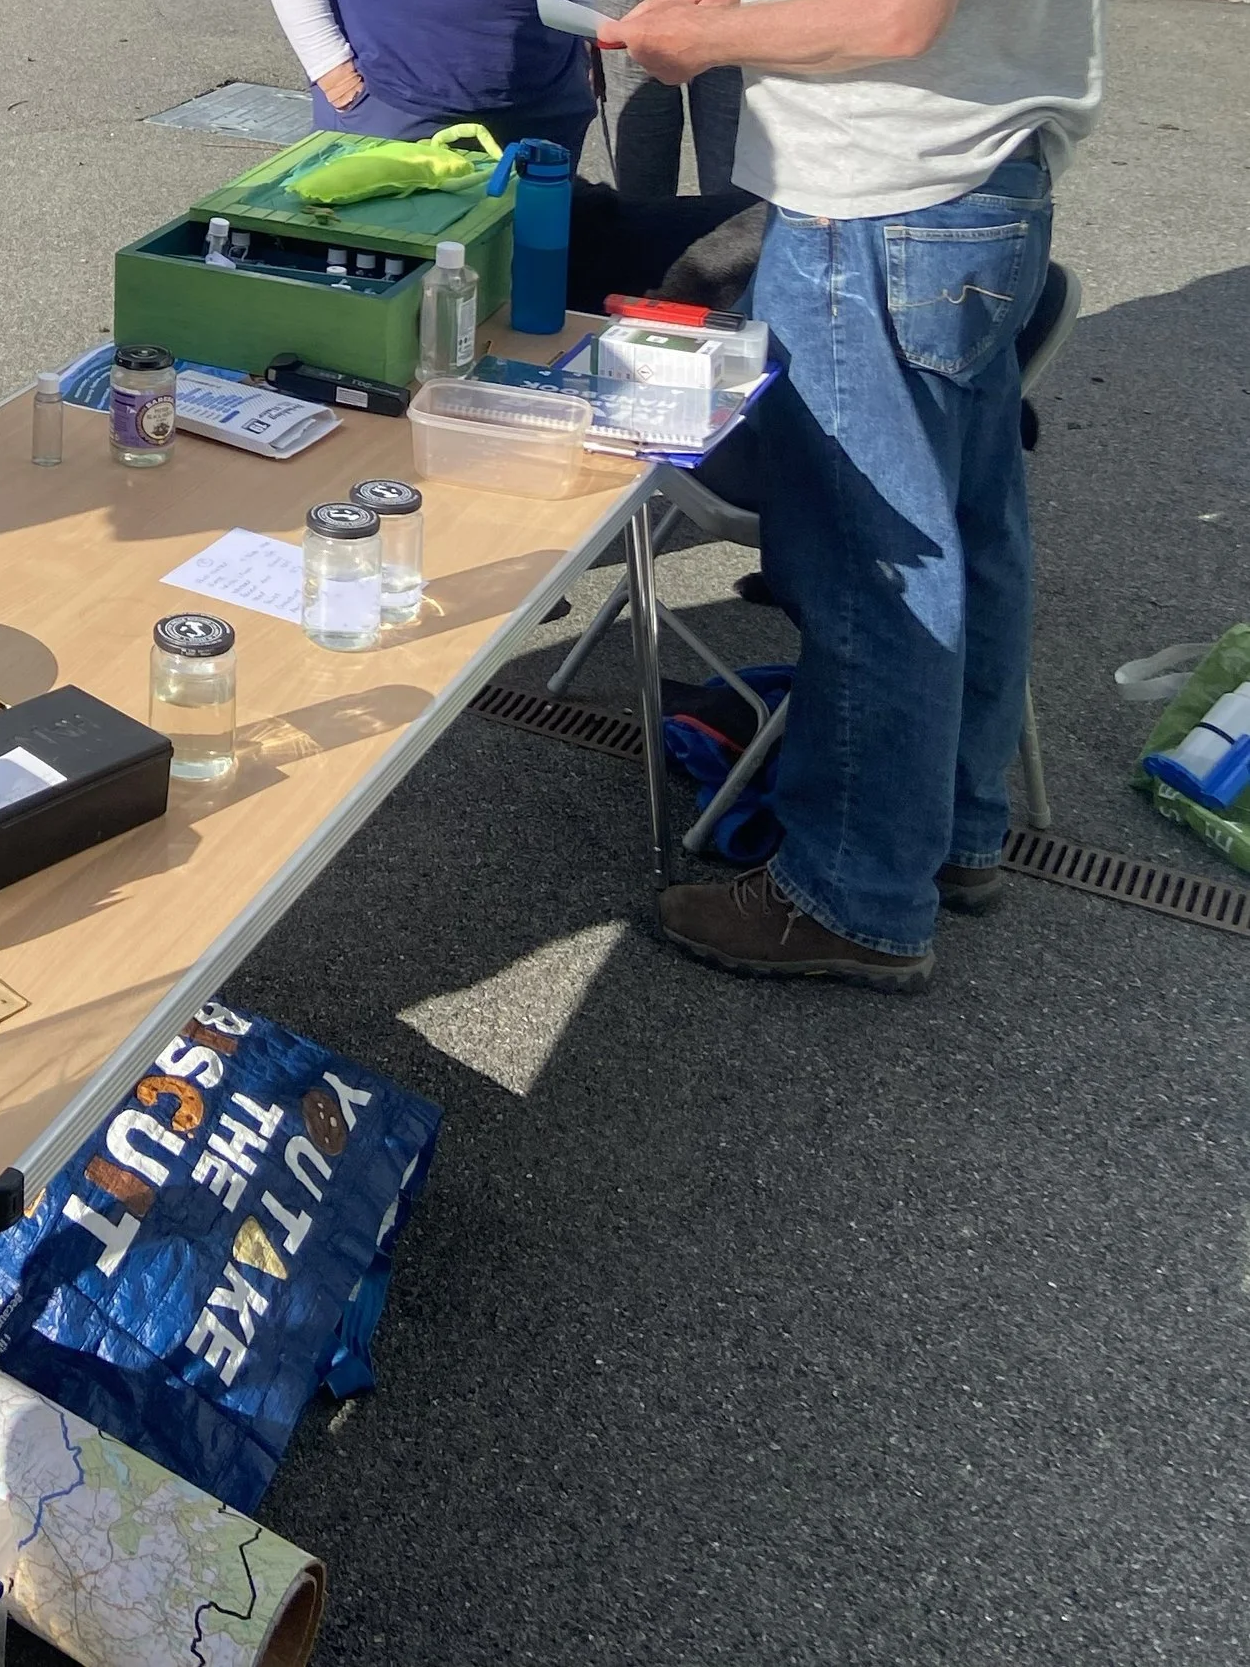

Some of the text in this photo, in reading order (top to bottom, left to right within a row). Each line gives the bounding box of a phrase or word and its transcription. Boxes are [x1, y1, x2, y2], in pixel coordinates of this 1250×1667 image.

[62, 1001, 253, 1278] BISCUIT
[185, 1071, 373, 1387] YOU TAKE
[191, 1091, 285, 1214] THE
